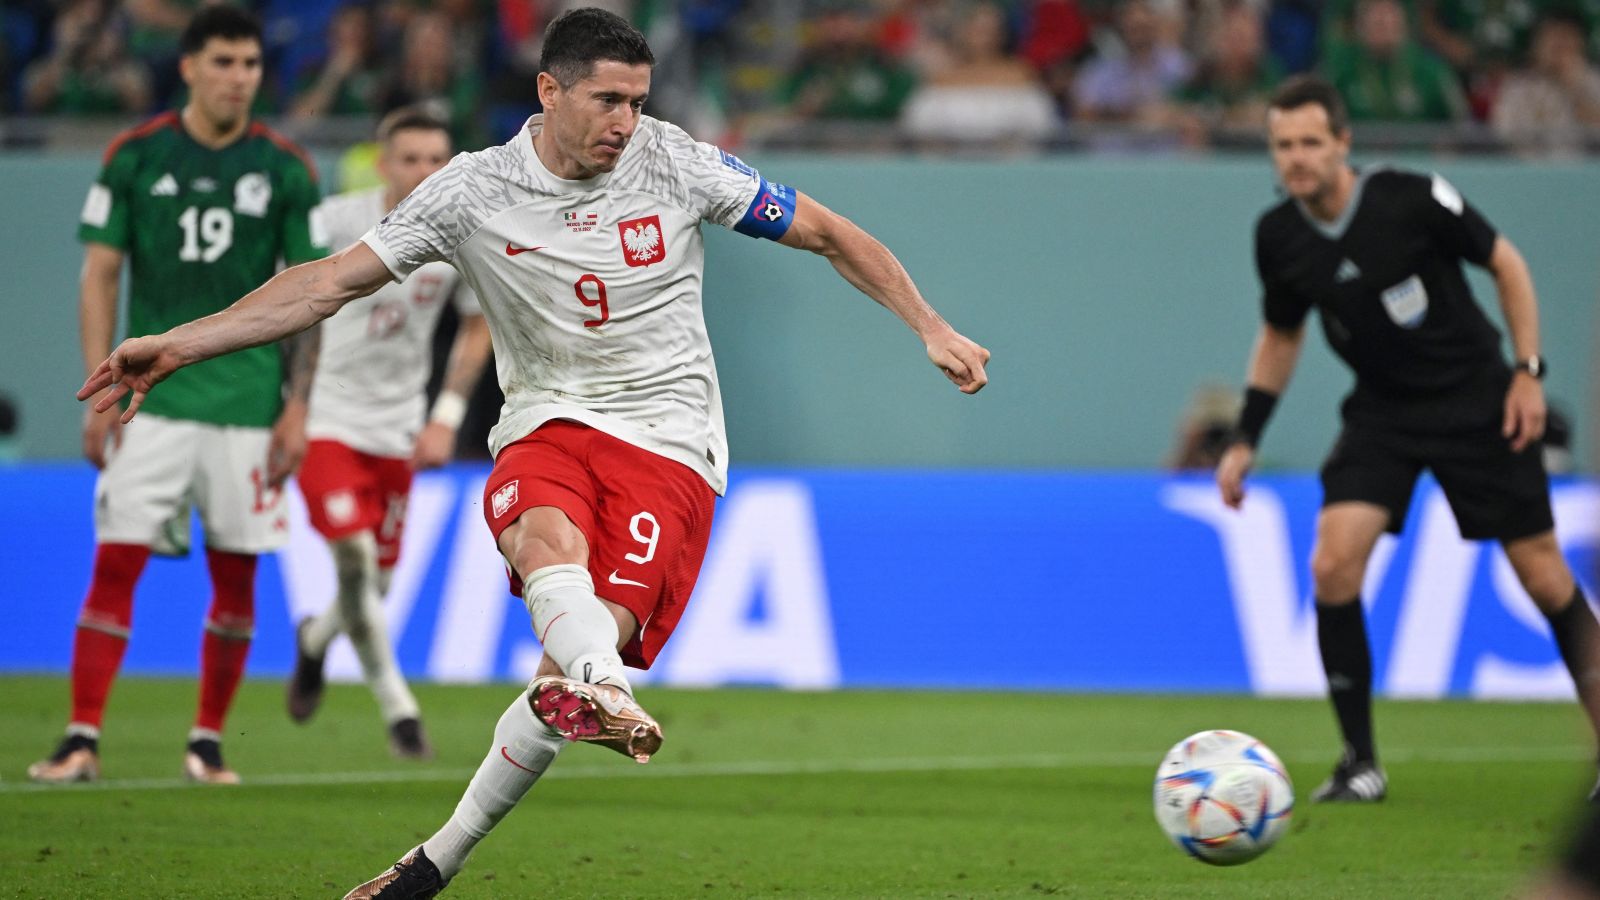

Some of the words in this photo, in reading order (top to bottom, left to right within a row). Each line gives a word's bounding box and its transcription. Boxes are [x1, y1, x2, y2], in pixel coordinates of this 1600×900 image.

[178, 206, 234, 263] 19
[574, 274, 609, 328] 9
[624, 511, 661, 565] 9
[277, 478, 839, 687] VIA
